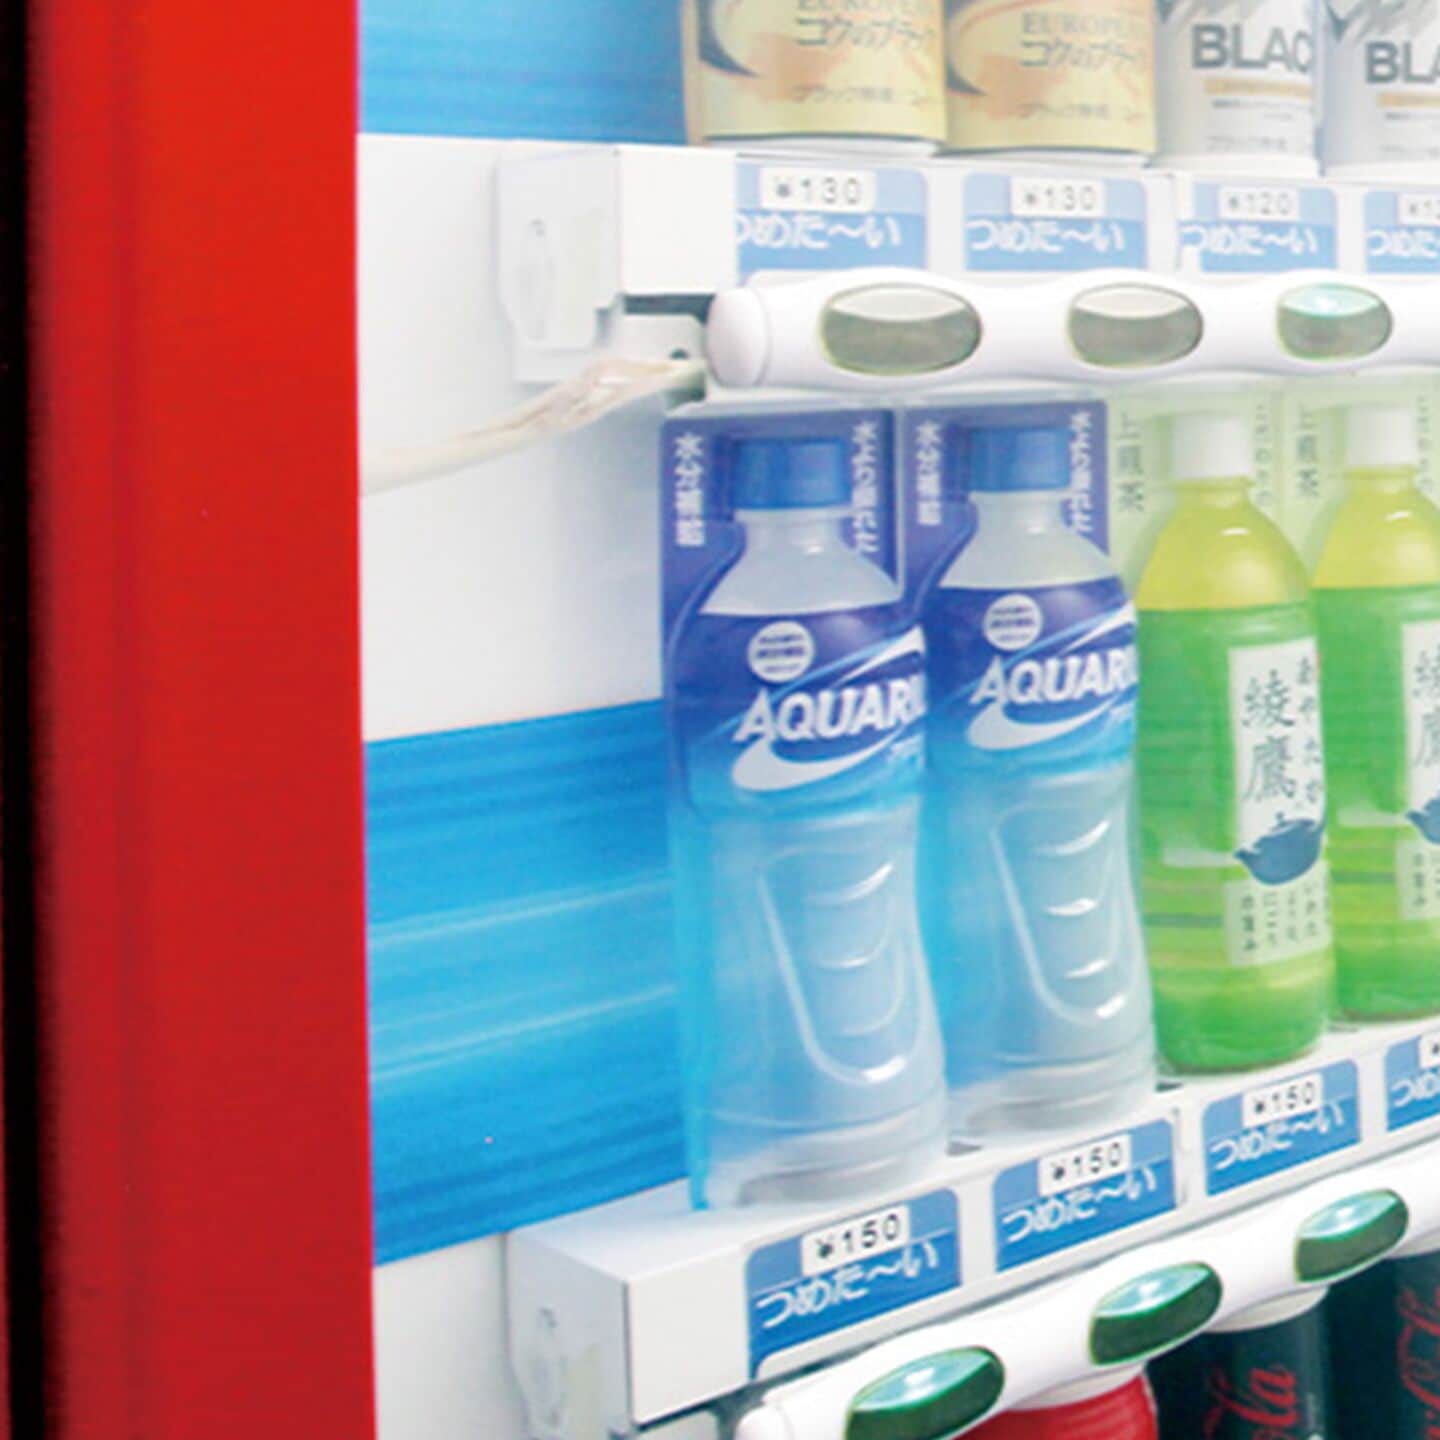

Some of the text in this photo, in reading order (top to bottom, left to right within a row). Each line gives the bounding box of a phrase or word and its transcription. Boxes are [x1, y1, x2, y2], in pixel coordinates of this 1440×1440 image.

[772, 176, 863, 206] ¥130
[1025, 184, 1099, 212] ¥130
[1226, 189, 1291, 216] ¥120
[1241, 668, 1297, 801] 綾鷹
[1254, 1080, 1317, 1118] ¥150
[1050, 1140, 1123, 1181] ¥150
[814, 1212, 902, 1259] ¥150
